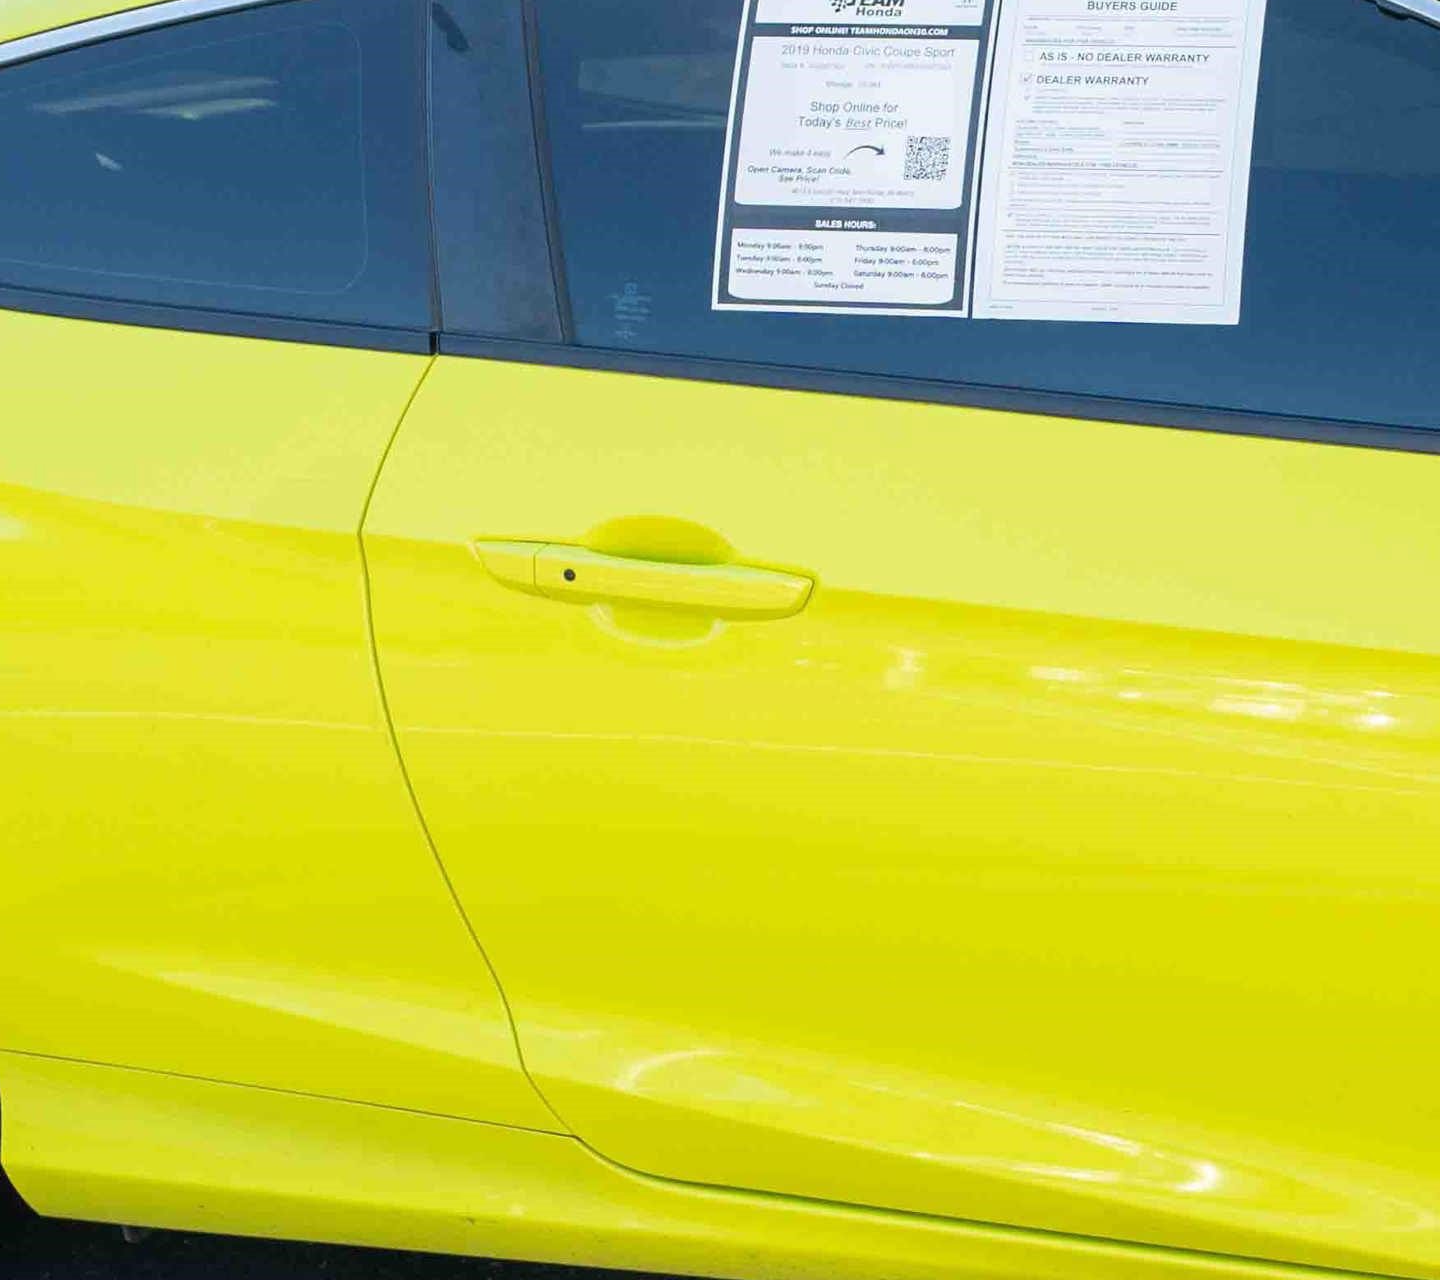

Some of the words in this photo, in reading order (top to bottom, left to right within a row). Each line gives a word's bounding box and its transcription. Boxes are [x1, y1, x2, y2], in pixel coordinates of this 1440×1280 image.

[1087, 0, 1137, 11] BUYERS
[1140, 1, 1178, 11] GUIDE
[855, 7, 902, 17] Honda
[790, 26, 814, 35] SHOP
[781, 44, 810, 56] 2019
[813, 45, 850, 57] Honda
[853, 45, 881, 57] Civic
[883, 46, 922, 59] Coupe
[924, 47, 956, 60] Sport
[1039, 52, 1055, 62] AS
[1057, 52, 1068, 62] IS
[1077, 52, 1094, 63] NO
[1096, 53, 1142, 63] DEALER
[1145, 53, 1210, 64] WARRANTY
[1036, 75, 1082, 85] DEALER
[1084, 76, 1150, 86] WARRANTY
[810, 101, 839, 113] Shop
[843, 101, 880, 113] Online
[882, 102, 899, 113] for
[798, 116, 842, 129] Today's
[845, 118, 871, 130] Best
[874, 117, 908, 129] Price!
[815, 220, 842, 229] SALES
